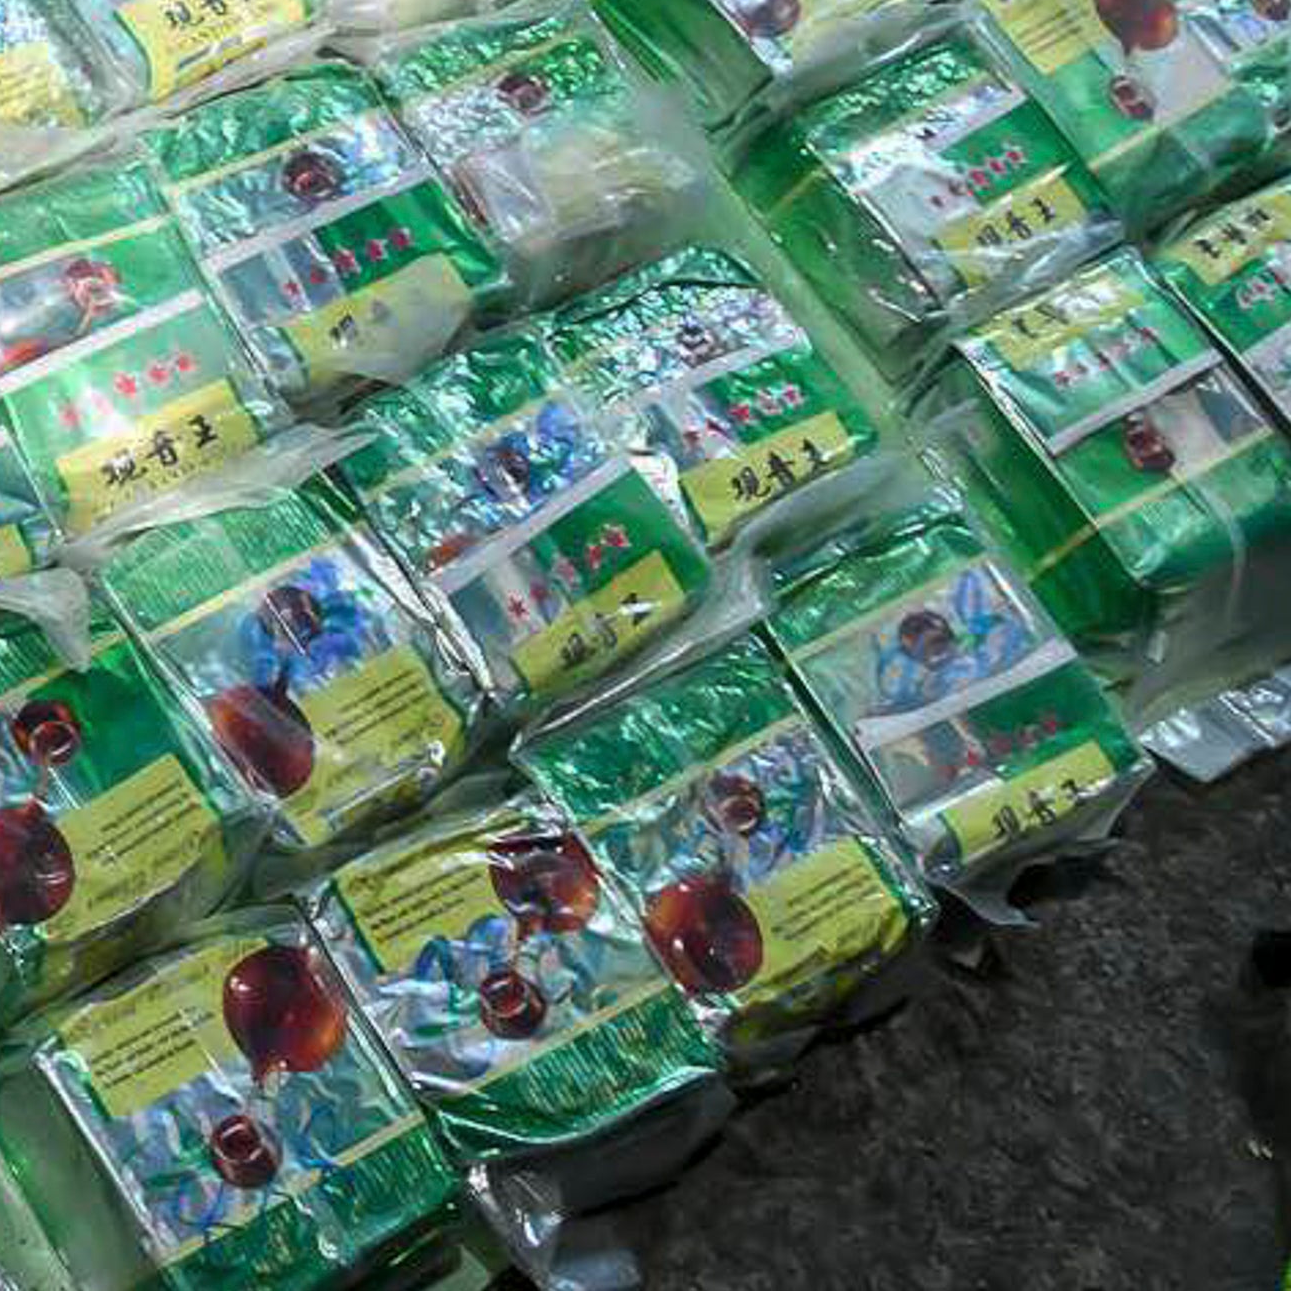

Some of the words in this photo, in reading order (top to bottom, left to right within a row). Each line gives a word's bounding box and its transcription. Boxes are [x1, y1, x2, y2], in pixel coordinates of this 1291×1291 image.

[99, 414, 218, 487] 观音王
[730, 437, 831, 505] 观音王
